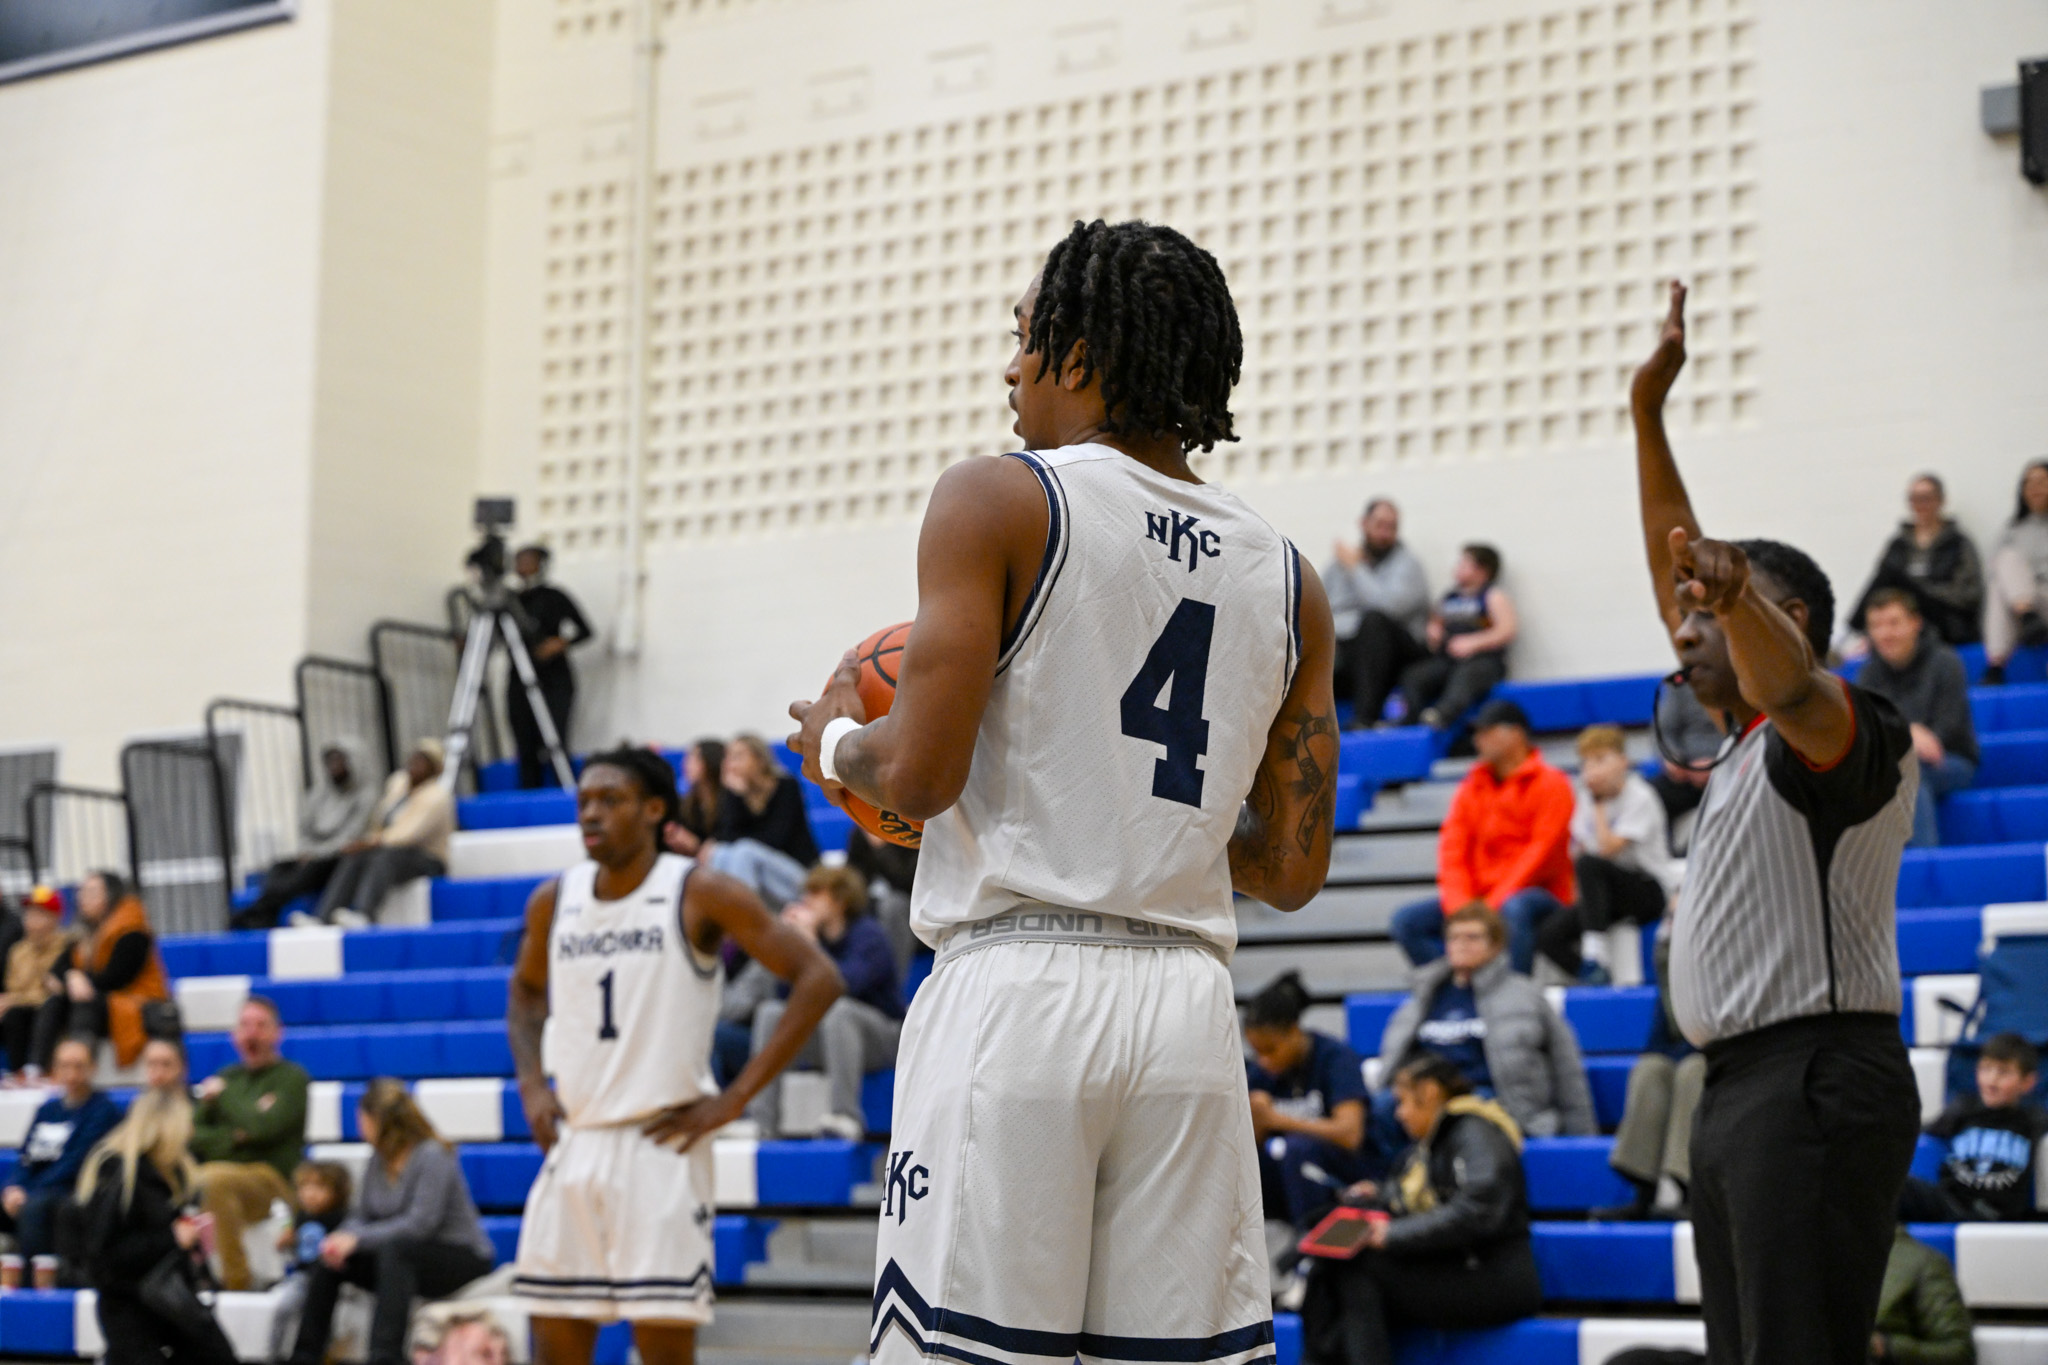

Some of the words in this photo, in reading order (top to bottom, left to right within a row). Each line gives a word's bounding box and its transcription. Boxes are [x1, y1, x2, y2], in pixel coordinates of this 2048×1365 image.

[1145, 508, 1221, 574] NKC
[1120, 597, 1216, 810] 4
[969, 913, 1102, 940] UNDER
[597, 968, 619, 1040] 1
